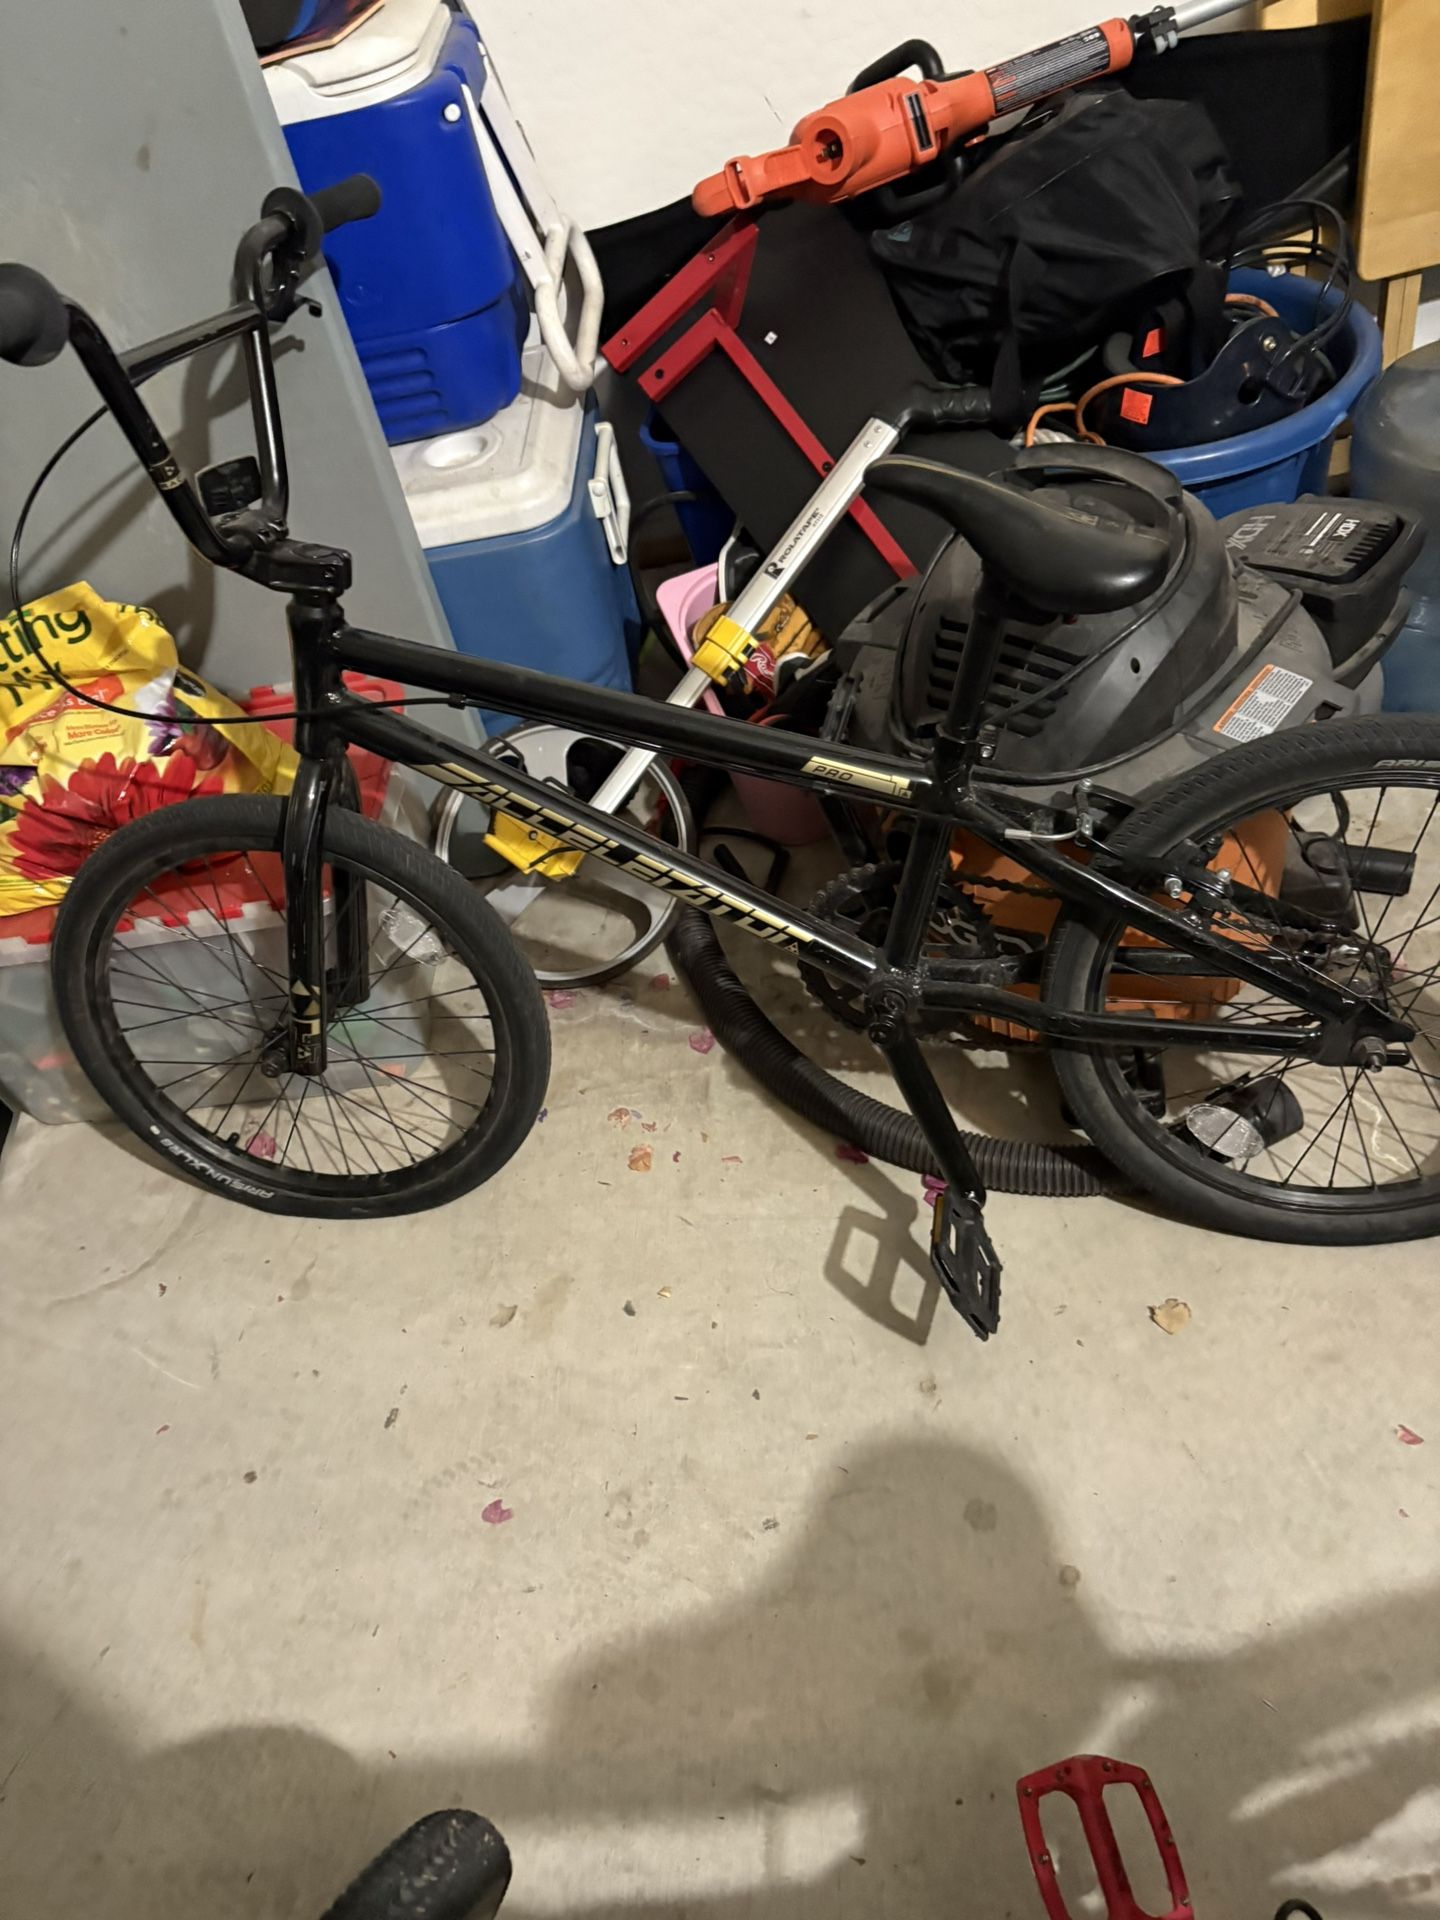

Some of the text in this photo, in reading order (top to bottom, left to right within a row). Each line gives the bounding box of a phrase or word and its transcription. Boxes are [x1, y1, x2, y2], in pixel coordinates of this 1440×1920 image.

[778, 511, 819, 563] ROLATAPE
[1224, 515, 1276, 550] HDX
[1332, 518, 1361, 538] HDX
[812, 765, 854, 782] PRO
[206, 1167, 275, 1199] ARISUN
